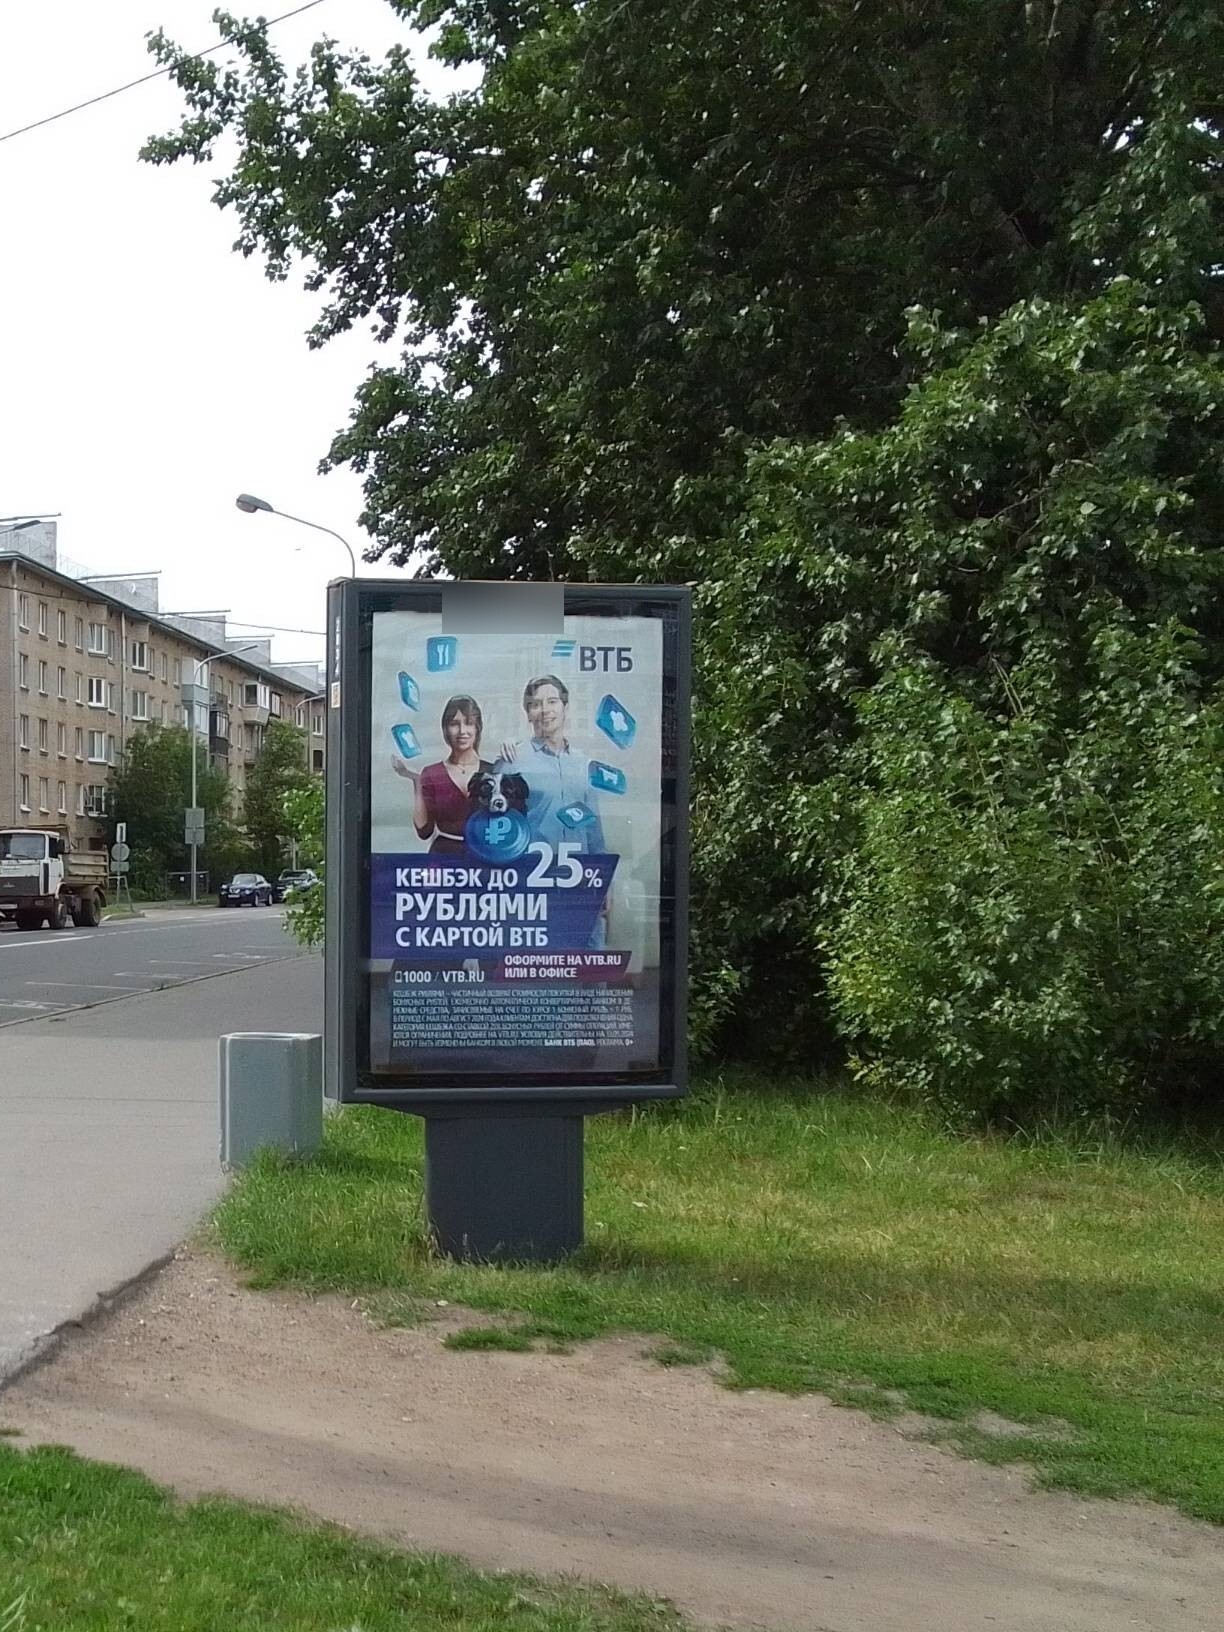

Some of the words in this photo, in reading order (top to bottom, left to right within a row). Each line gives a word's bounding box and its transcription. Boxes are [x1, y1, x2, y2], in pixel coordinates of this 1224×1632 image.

[579, 646, 633, 673] ВТБ
[395, 867, 483, 889] КЕШБЭК
[487, 867, 518, 891] ДО
[526, 842, 603, 889] 25%
[395, 893, 548, 921] РУБЛЯМИ
[395, 926, 410, 947] С
[415, 922, 504, 947] КАРТОЙ
[509, 926, 549, 947] ВТБ
[504, 955, 565, 966] ОФОРМИТЕ
[567, 955, 583, 966] НА
[585, 955, 622, 966] VTB.RU
[504, 967, 527, 978] ИЛИ
[529, 967, 538, 978] В
[539, 967, 577, 978] ОФИСЕ
[403, 971, 431, 983] 1000
[442, 971, 485, 983] VTB.RU
